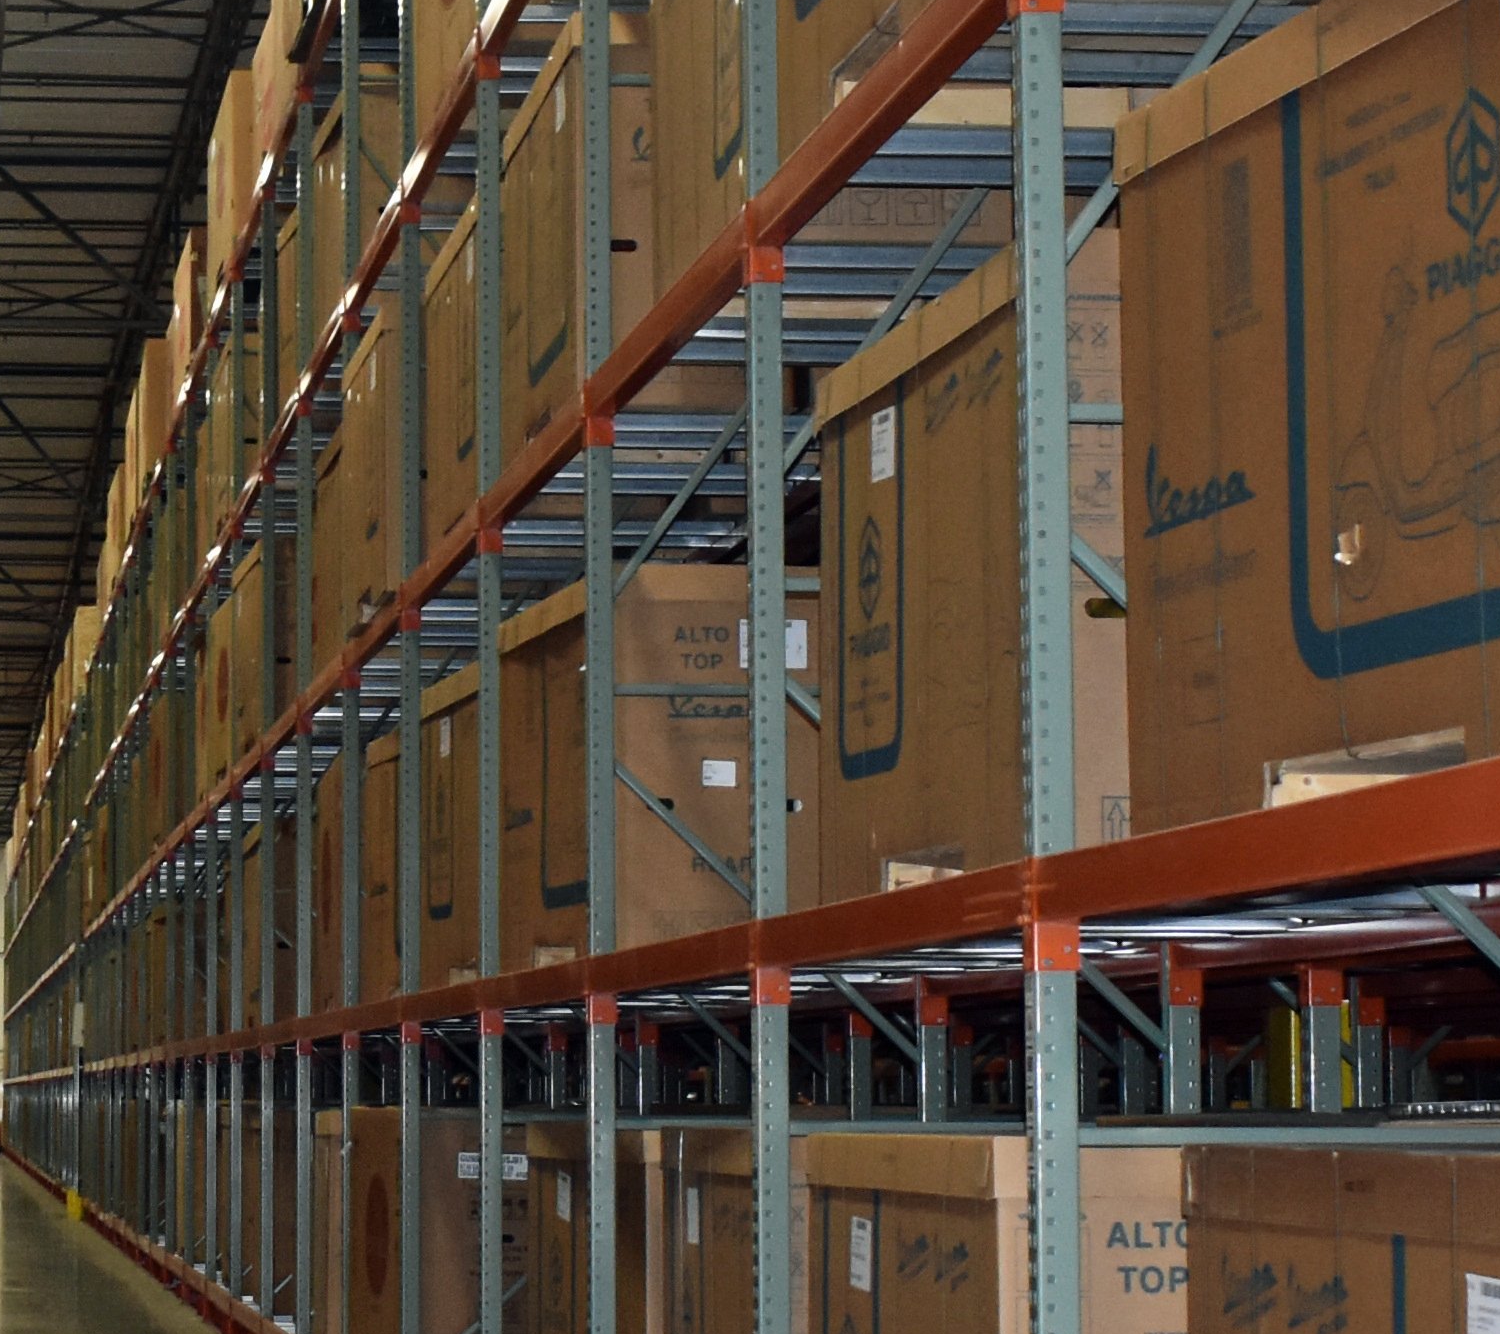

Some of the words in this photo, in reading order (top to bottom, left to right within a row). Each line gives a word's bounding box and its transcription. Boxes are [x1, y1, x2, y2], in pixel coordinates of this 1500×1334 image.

[1143, 443, 1257, 539] Vespa
[675, 626, 730, 643] ALTO
[681, 652, 724, 670] TOP
[1117, 1266, 1189, 1293] TOP
